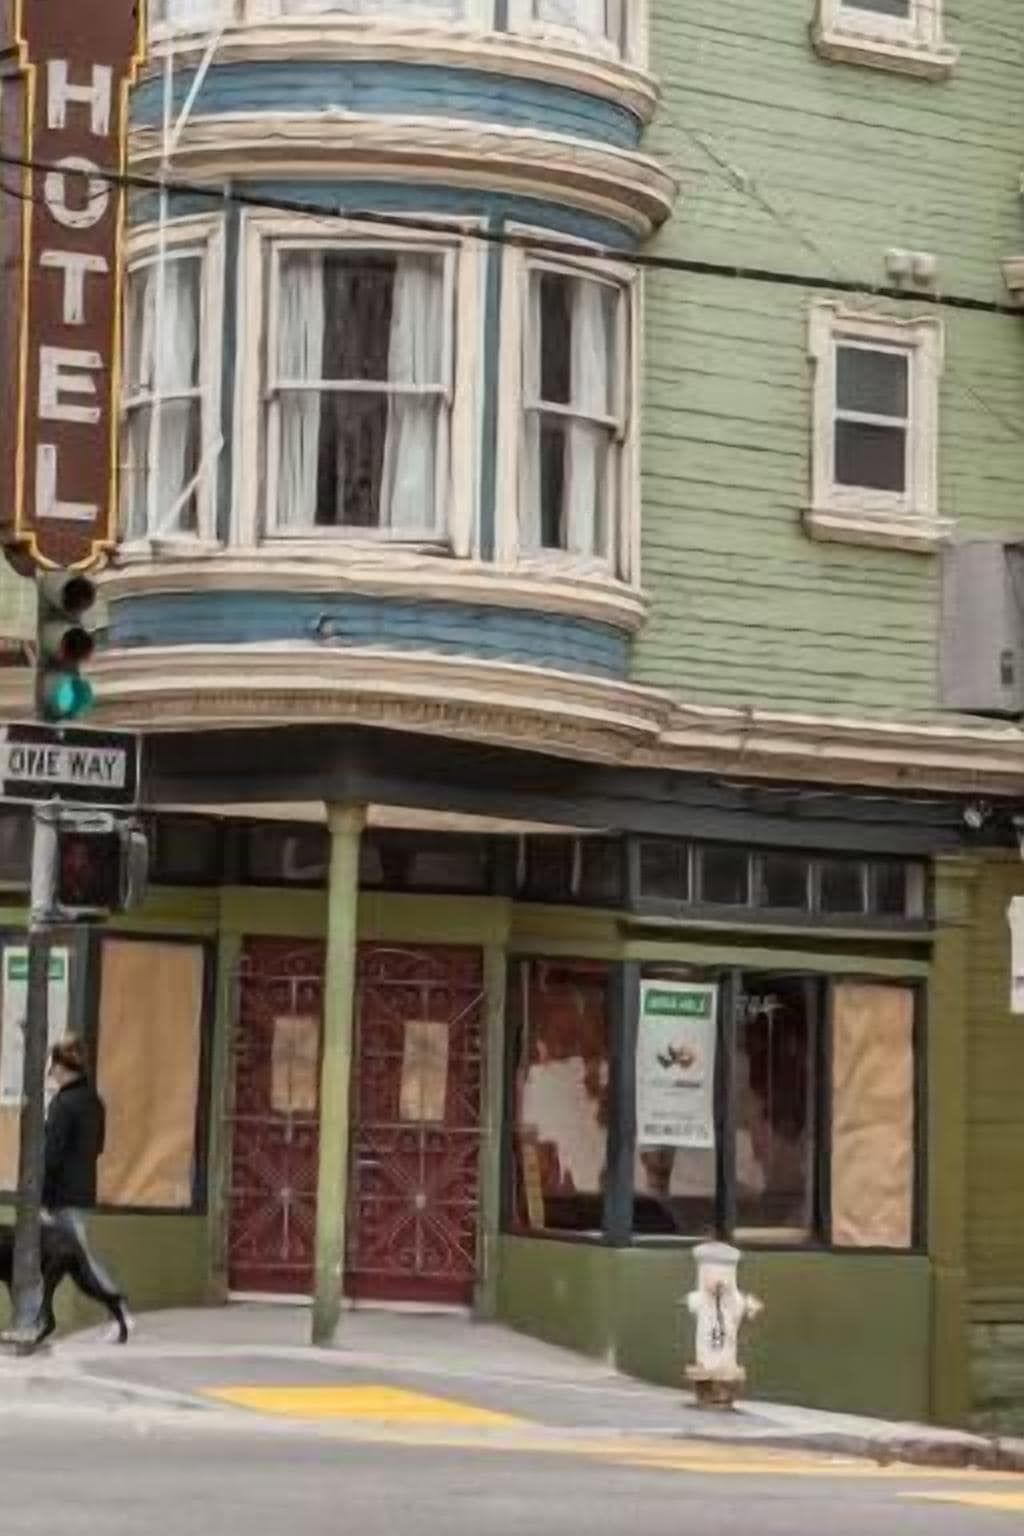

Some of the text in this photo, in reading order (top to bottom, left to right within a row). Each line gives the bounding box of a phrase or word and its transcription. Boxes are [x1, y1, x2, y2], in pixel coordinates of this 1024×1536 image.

[34, 58, 113, 522] HOTEL
[8, 747, 117, 781] ONE WAY
